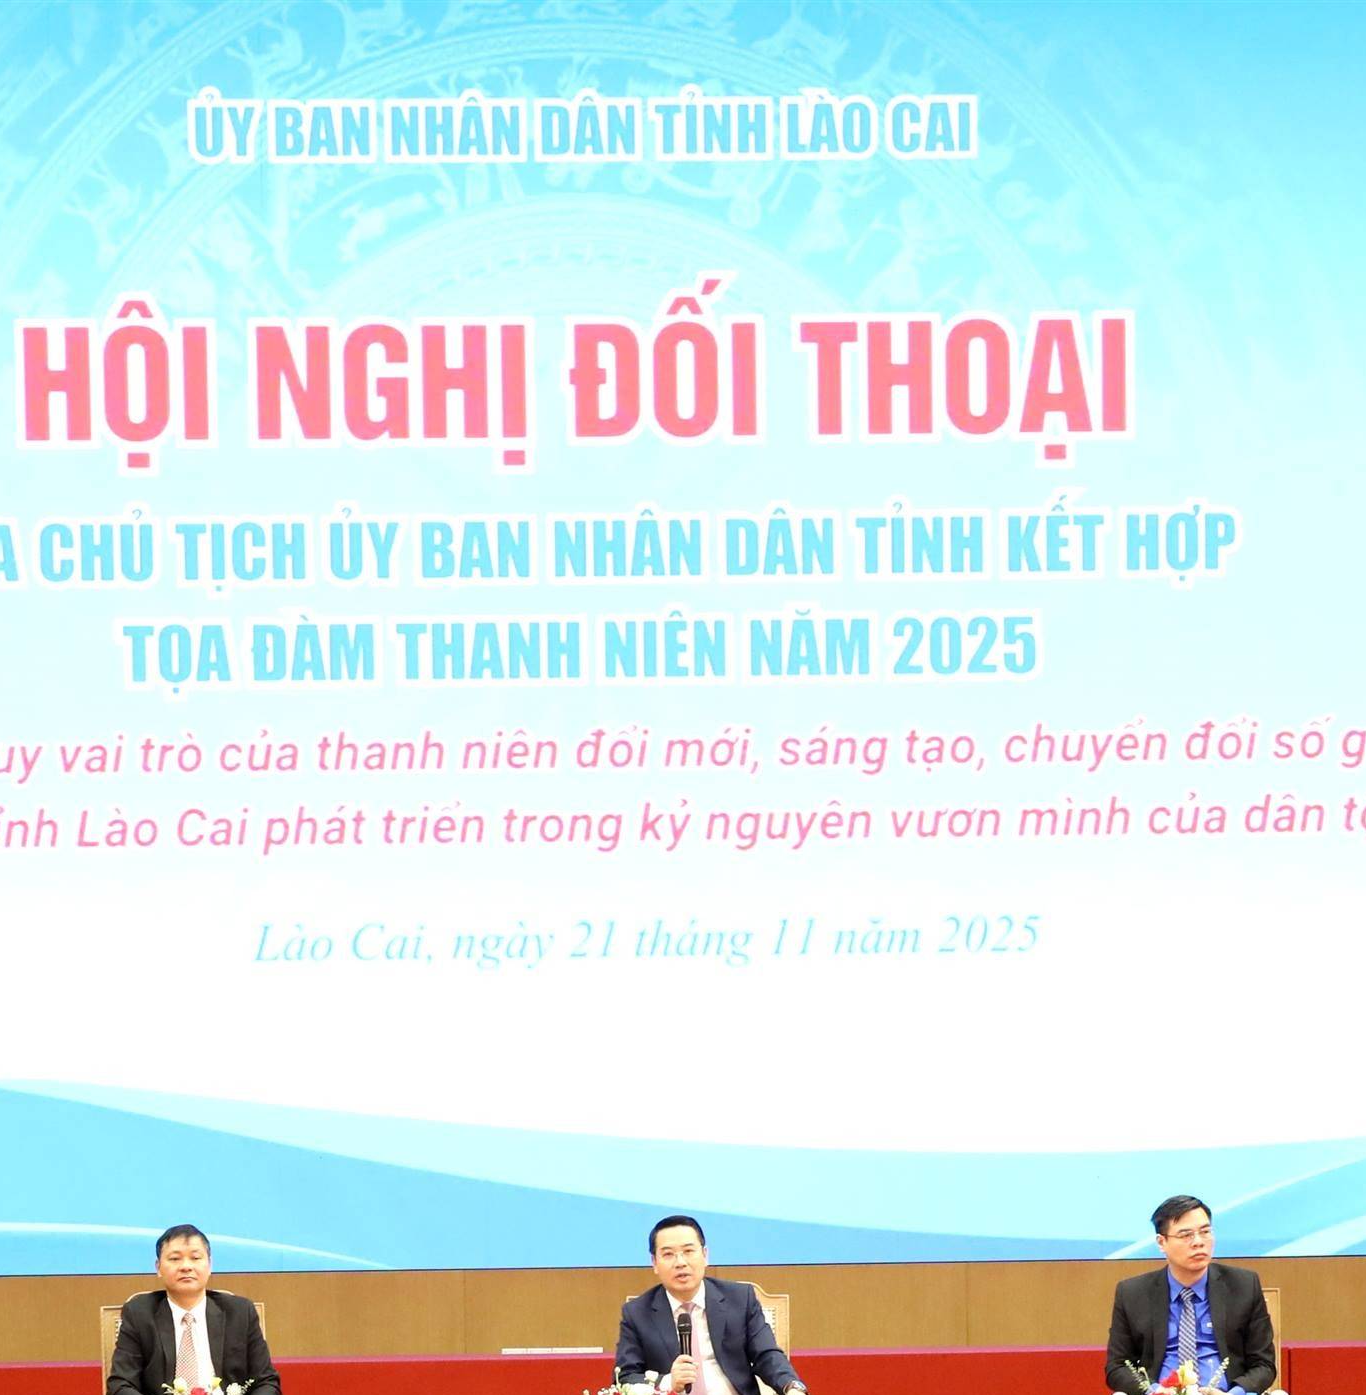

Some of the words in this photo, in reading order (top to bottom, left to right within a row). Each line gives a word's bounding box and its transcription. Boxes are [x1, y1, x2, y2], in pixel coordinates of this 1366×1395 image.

[197, 89, 257, 156] ỦY
[276, 104, 371, 156] BAN
[390, 91, 523, 155] NHÂN
[541, 91, 635, 155] DÂN
[658, 85, 765, 154] TỈNH
[785, 88, 875, 153] LÀO
[893, 101, 975, 152] CAI
[22, 299, 211, 469] HỘI
[254, 323, 528, 466] NGHỊ
[568, 278, 758, 439] ĐỐI
[798, 318, 1128, 462] THOẠI
[39, 510, 153, 581] CHỦ
[176, 522, 305, 591] TỊCH
[330, 508, 399, 580] ỦY
[421, 521, 529, 578] BAN
[554, 509, 702, 577] NHÂN
[725, 508, 833, 576] DÂN
[856, 502, 983, 573] TỈNH
[1008, 495, 1104, 572] KẾT
[1126, 504, 1235, 581] HỢP
[123, 624, 231, 693] TỌA
[251, 615, 374, 681] ĐÀM
[396, 622, 579, 679] THANH
[605, 610, 725, 678] NIÊN
[749, 609, 870, 676] NĂM
[893, 615, 1035, 676] 2025
[59, 734, 124, 774] vai
[139, 732, 202, 774] trò
[219, 728, 299, 773] của
[317, 730, 444, 771] thanh
[462, 728, 558, 769] niên
[576, 728, 649, 768] đổi
[663, 727, 758, 775] mới,
[779, 725, 888, 776] sáng
[906, 729, 985, 774] tạo,
[1004, 719, 1168, 773] chuyển
[1184, 717, 1259, 761] đổi
[1273, 717, 1331, 759] số
[75, 809, 159, 848] Lào
[177, 807, 250, 847] Cai
[263, 805, 366, 856] phát
[382, 803, 485, 848] triển
[503, 808, 623, 853] trong
[639, 799, 691, 852] kỷ
[705, 800, 872, 852] nguyên
[891, 804, 1001, 839] vươn
[1018, 795, 1131, 837] mình
[1147, 791, 1227, 835] của
[1244, 793, 1325, 833] dân
[254, 922, 334, 961] Lào
[347, 923, 432, 964] Cai,
[453, 920, 554, 971] ngày
[570, 919, 616, 959] 21
[635, 918, 752, 967] tháng
[773, 917, 815, 957] 11
[833, 918, 921, 955] năm
[938, 914, 1042, 954] 2025
